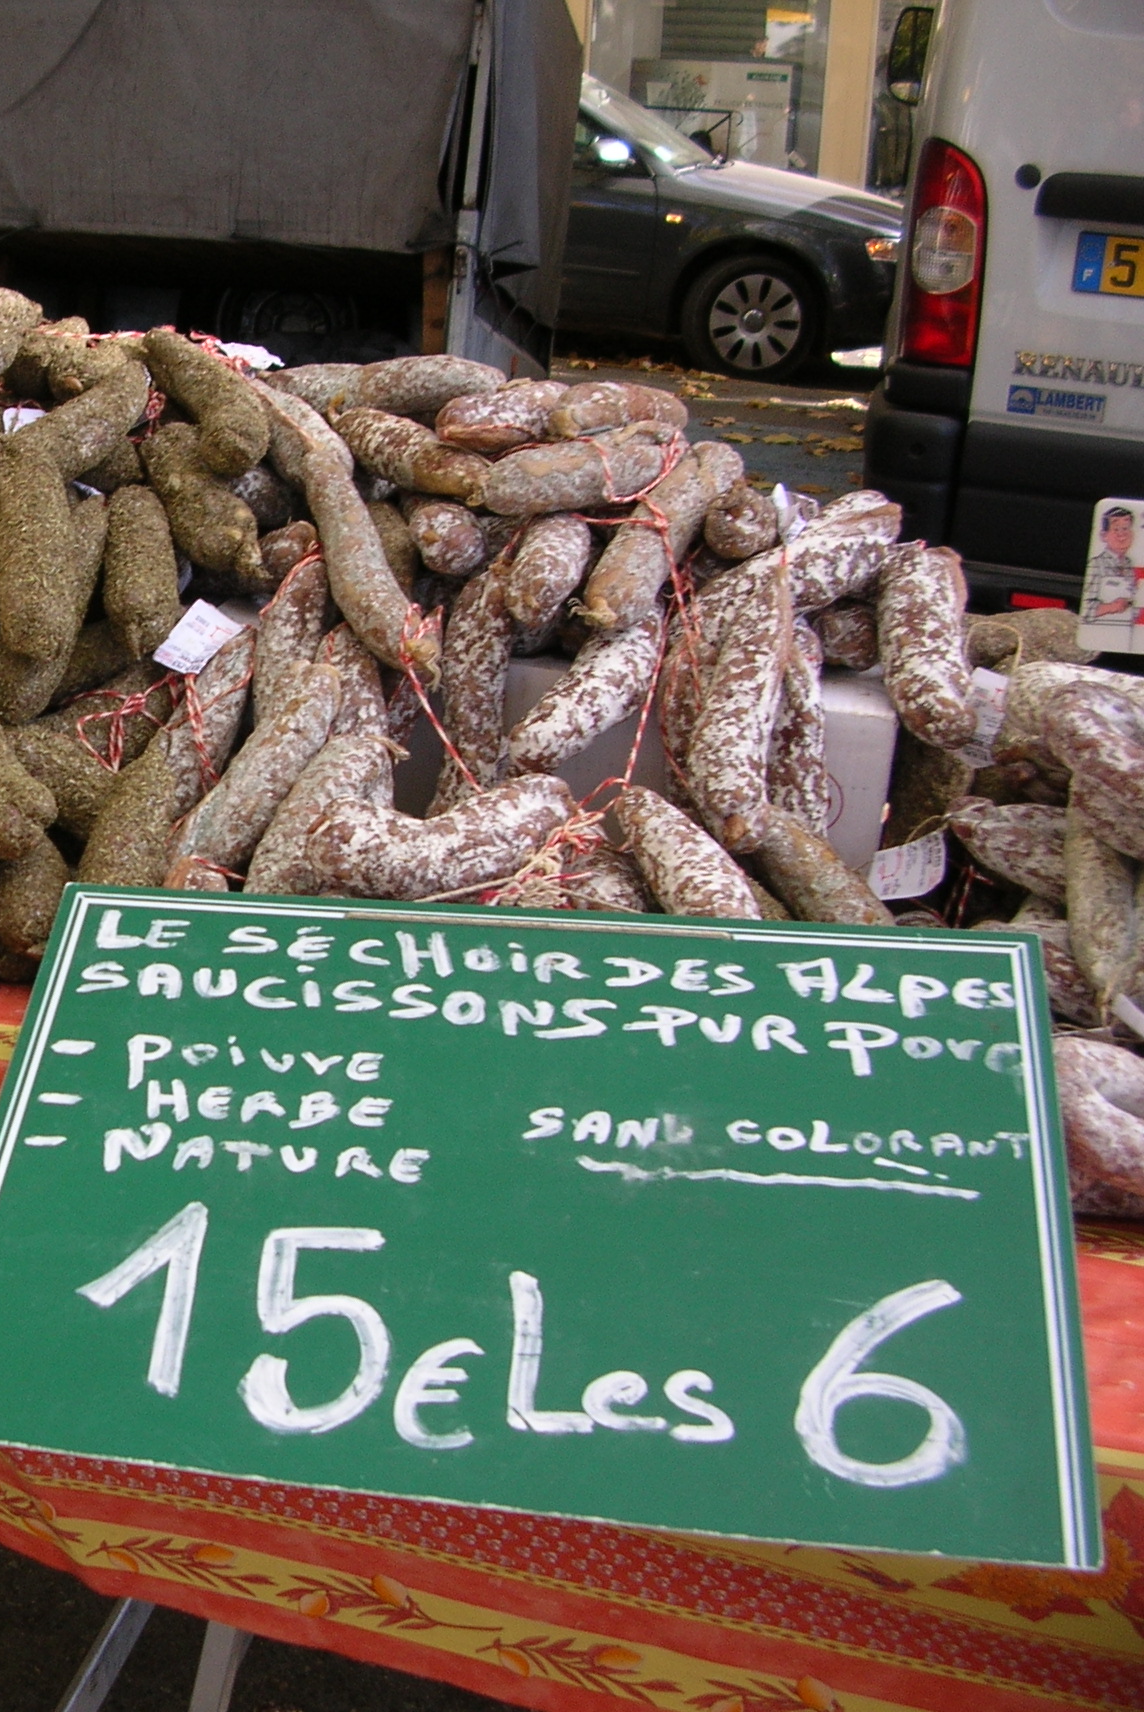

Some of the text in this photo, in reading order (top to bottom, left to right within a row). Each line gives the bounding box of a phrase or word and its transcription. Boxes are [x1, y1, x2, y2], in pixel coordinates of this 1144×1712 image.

[1082, 268, 1094, 282] F
[1110, 244, 1140, 288] 5
[1036, 390, 1105, 412] LAMBERT
[95, 909, 191, 950] LE
[602, 956, 756, 997] DES
[777, 957, 1015, 1019] ALPES
[622, 1004, 810, 1055] PUR
[146, 1079, 395, 1130] HERBE
[102, 1121, 432, 1184] NATURE
[725, 1118, 1030, 1160] COLORANT
[792, 1277, 968, 1489] 6
